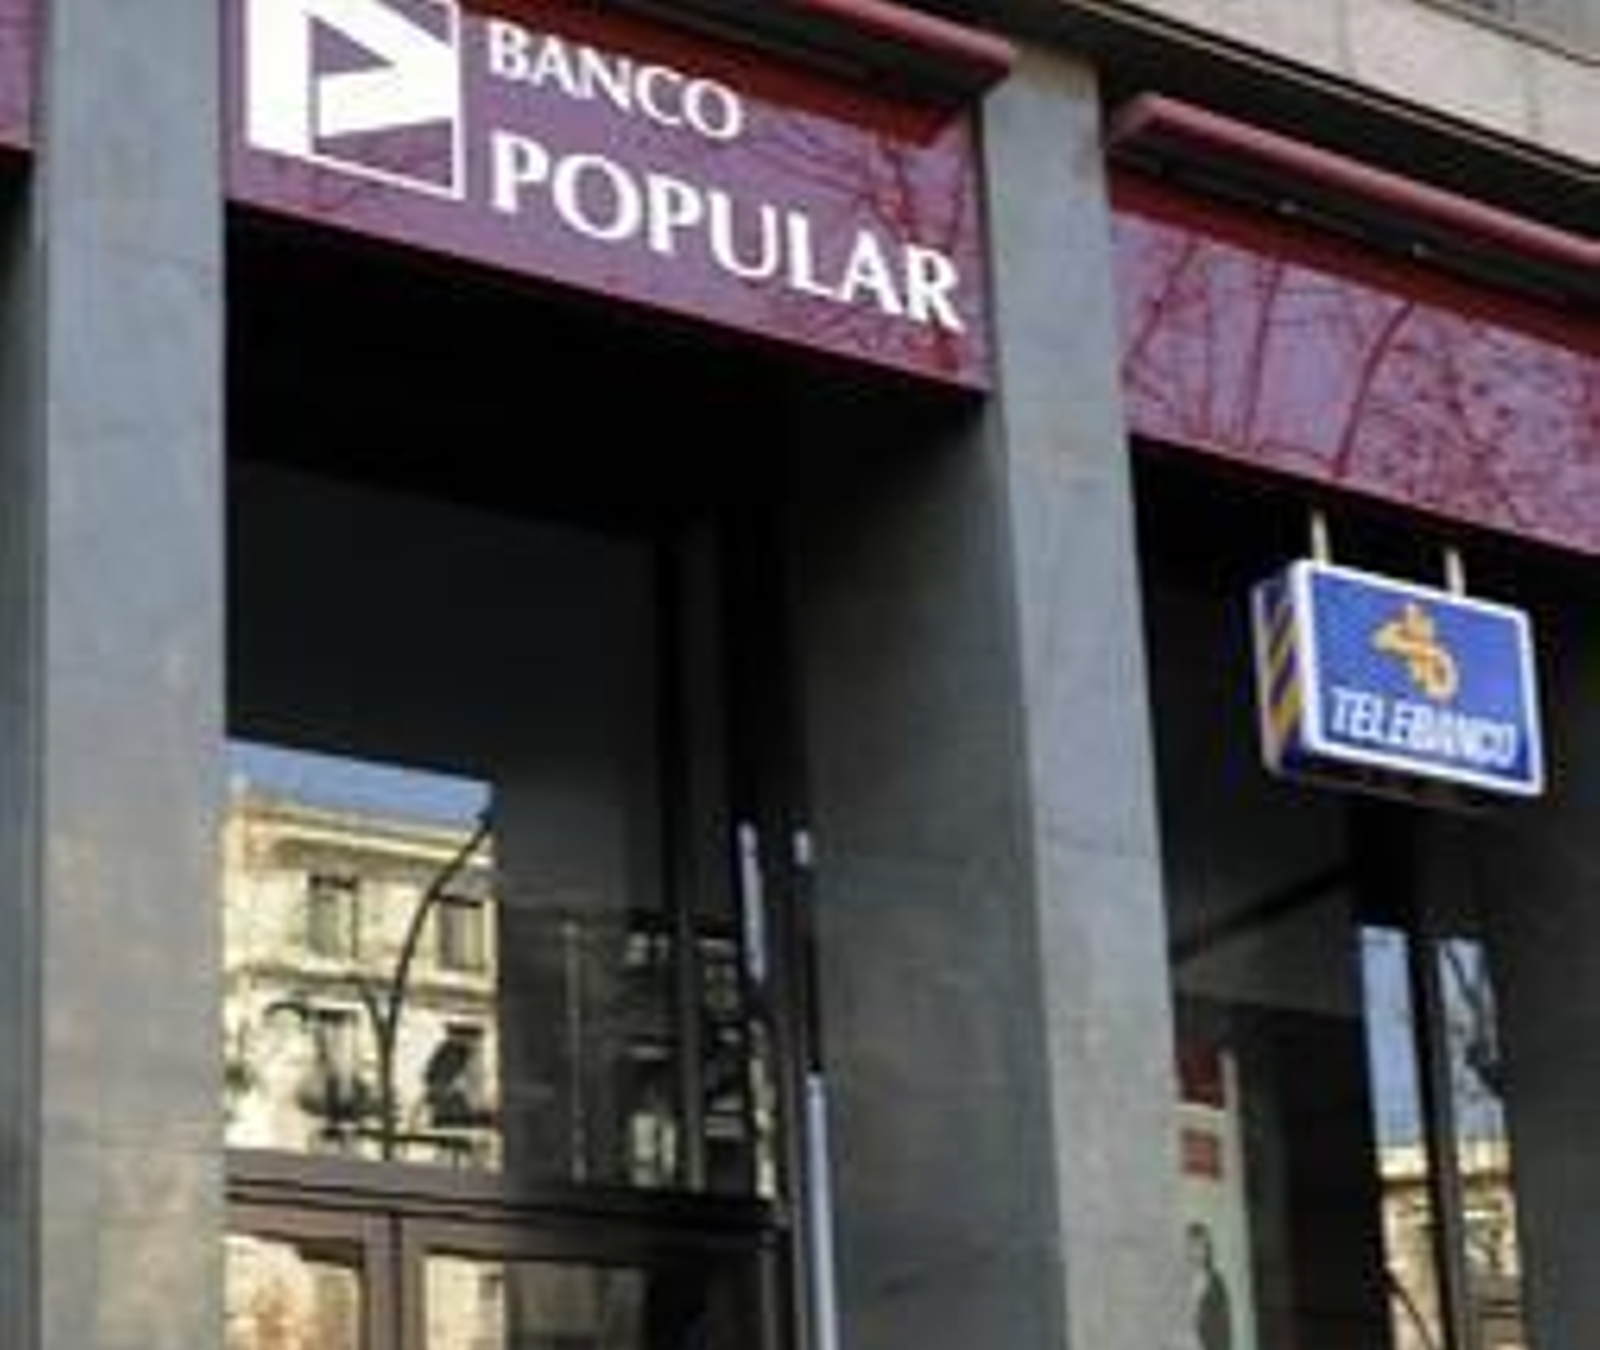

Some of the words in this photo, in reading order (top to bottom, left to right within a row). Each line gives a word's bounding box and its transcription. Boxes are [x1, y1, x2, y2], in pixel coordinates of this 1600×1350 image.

[486, 20, 745, 140] BANCO
[489, 129, 966, 333] POPULAR
[1331, 687, 1517, 769] TELEBANCO
